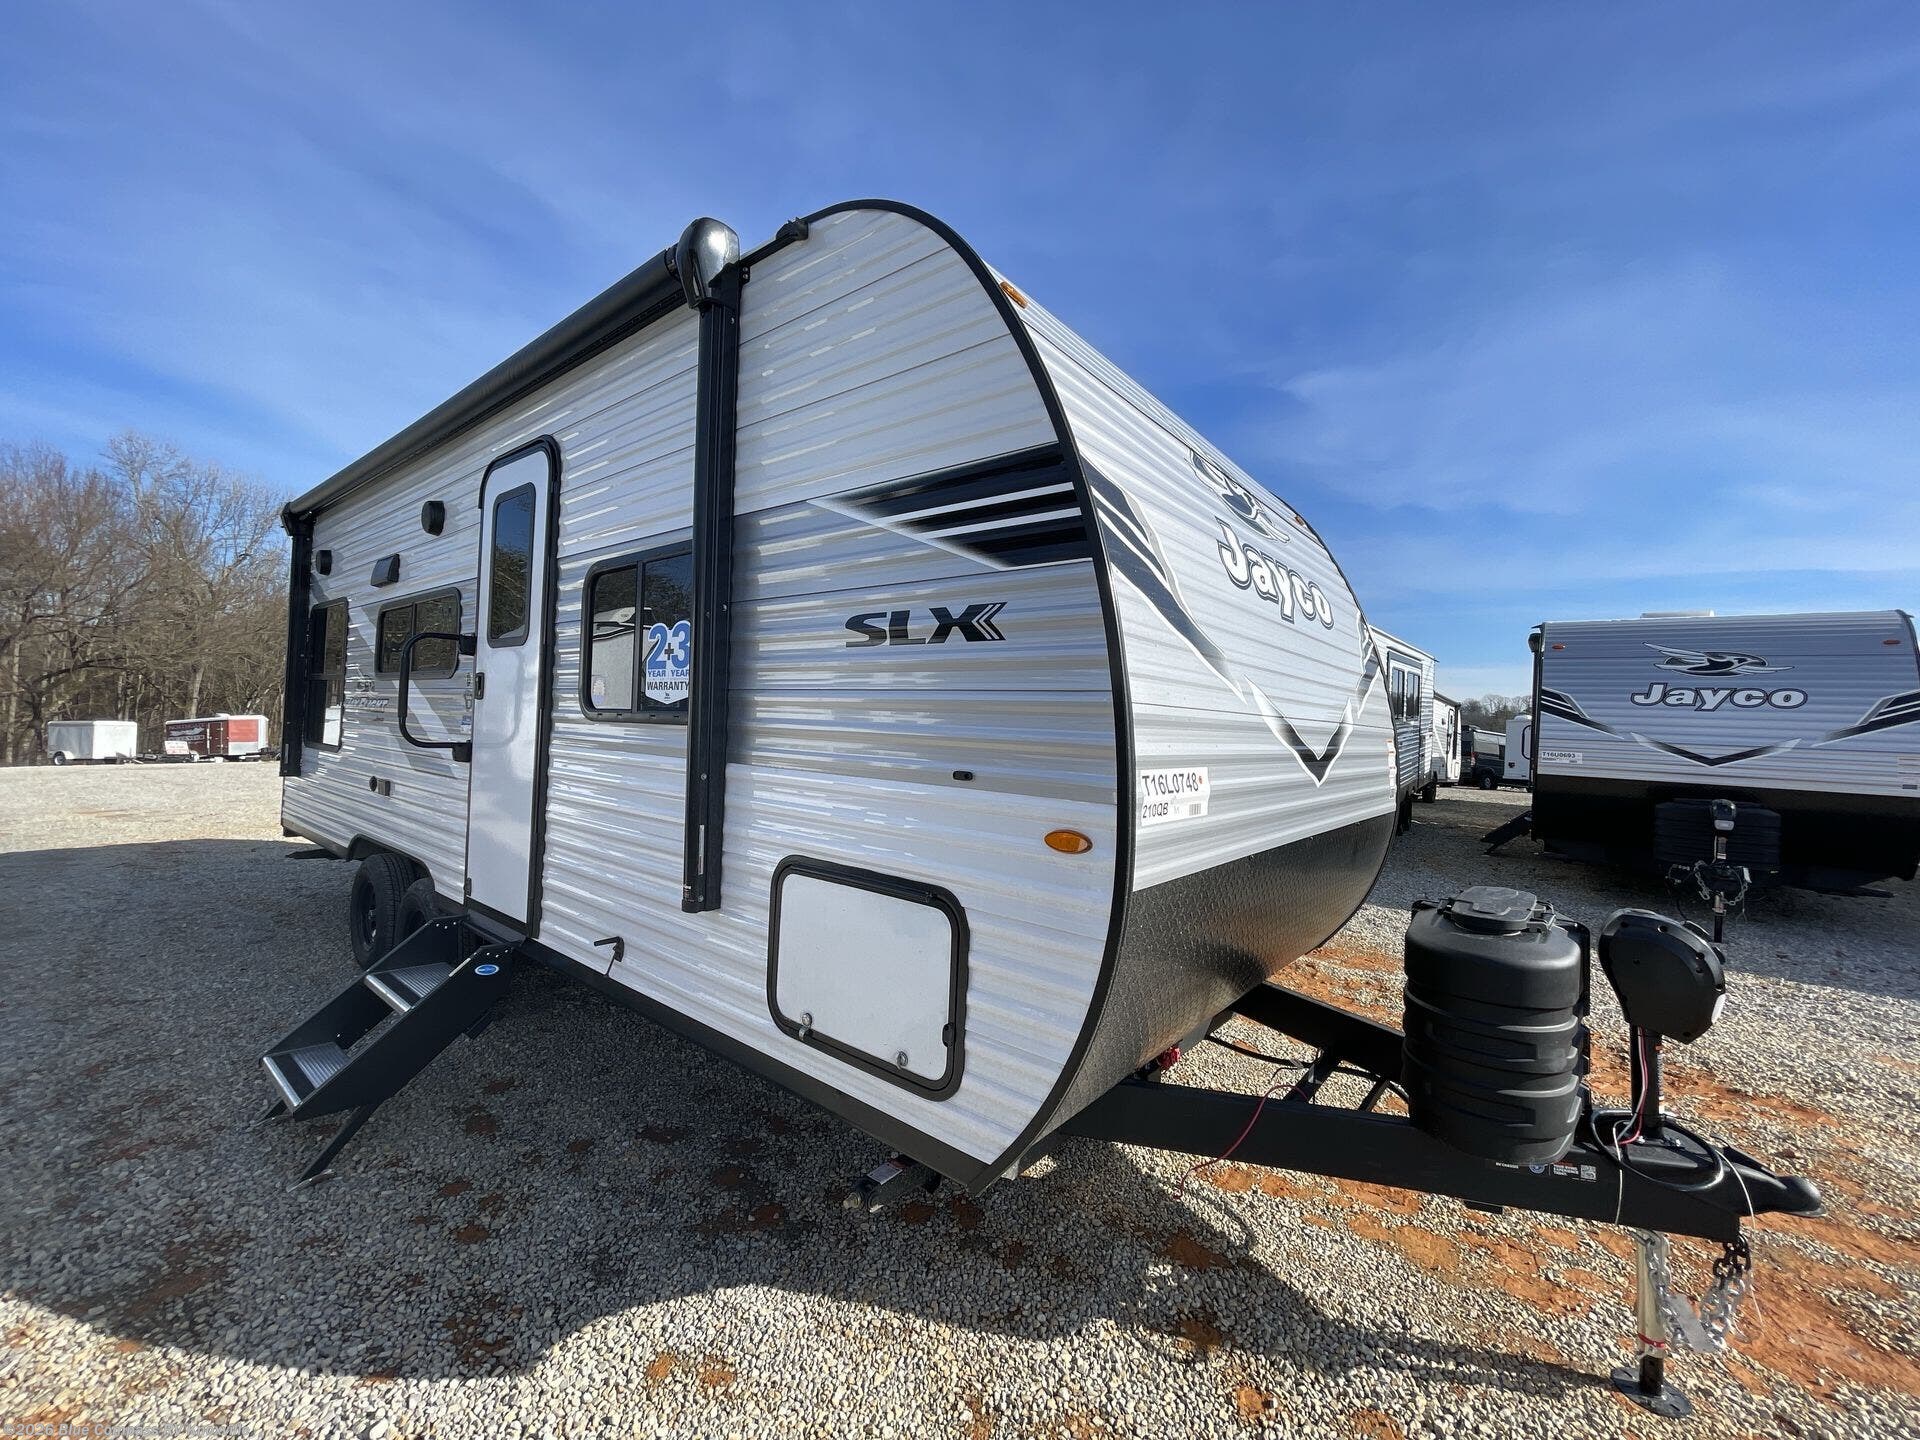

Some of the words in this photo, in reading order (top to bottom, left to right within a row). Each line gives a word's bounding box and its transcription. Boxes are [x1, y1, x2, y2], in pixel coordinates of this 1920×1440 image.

[1215, 515, 1335, 631] Jayco
[844, 601, 1008, 648] SLX
[646, 681, 690, 691] WARRANTY
[647, 669, 667, 678] YEAR
[1630, 682, 1808, 712] Jayco
[1141, 772, 1199, 797] T16L0748
[1142, 802, 1169, 819] 210QB
